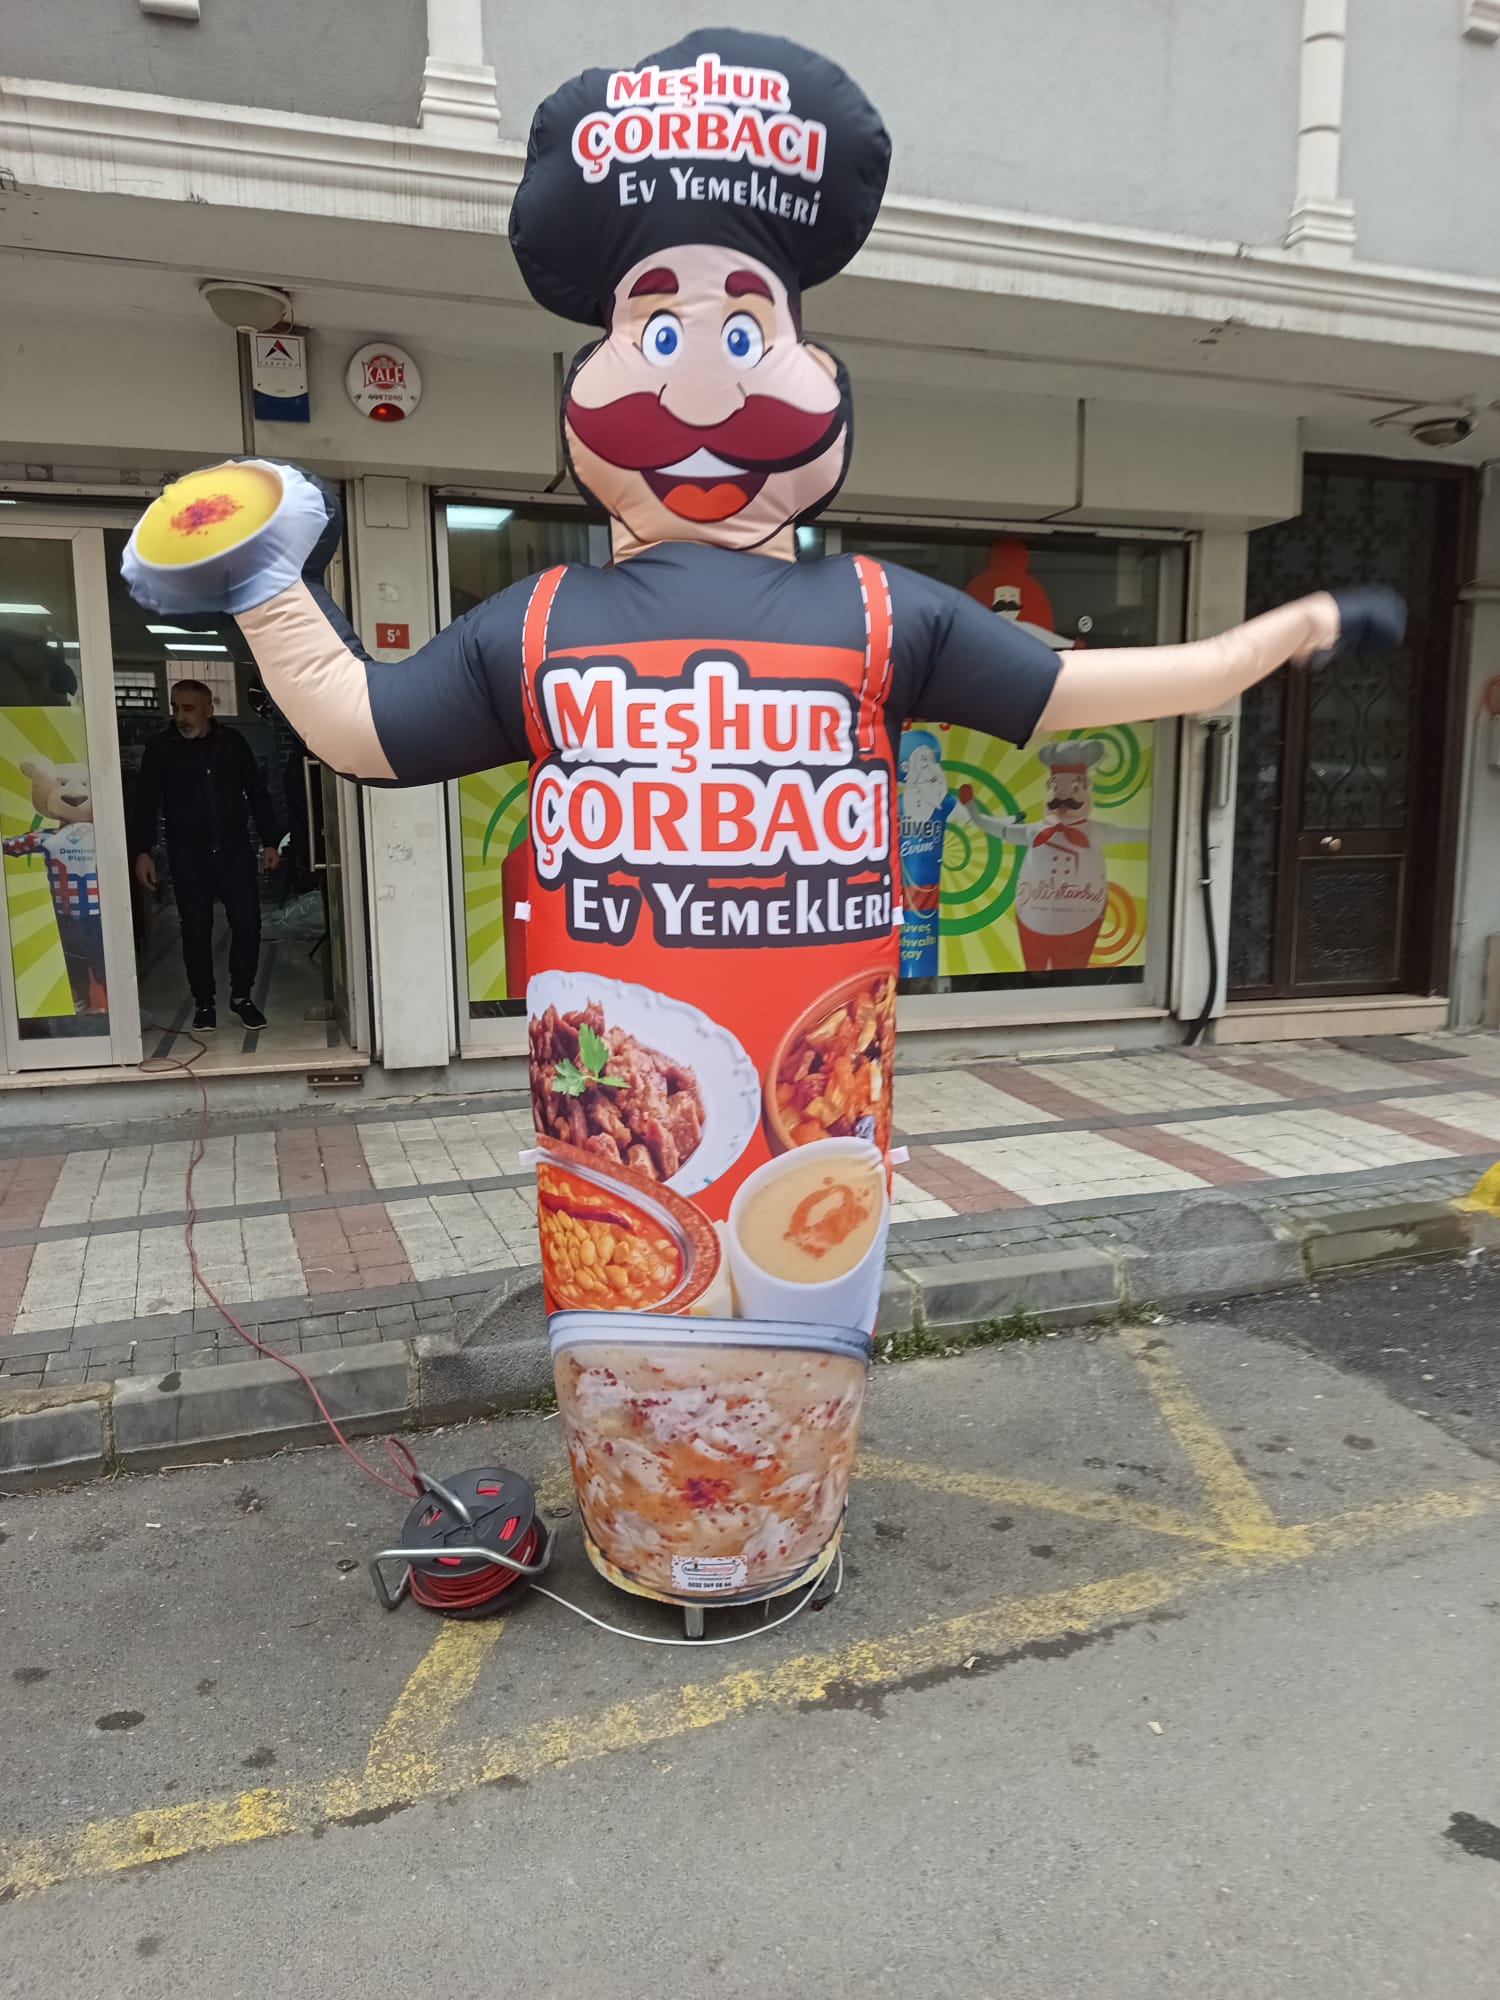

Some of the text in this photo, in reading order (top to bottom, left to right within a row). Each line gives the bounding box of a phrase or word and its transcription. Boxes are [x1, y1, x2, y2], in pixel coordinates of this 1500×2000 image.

[576, 112, 821, 174] ÇORBACI
[363, 366, 405, 385] KALE
[534, 776, 883, 866] ÇORBACI
[900, 815, 943, 843] üveç
